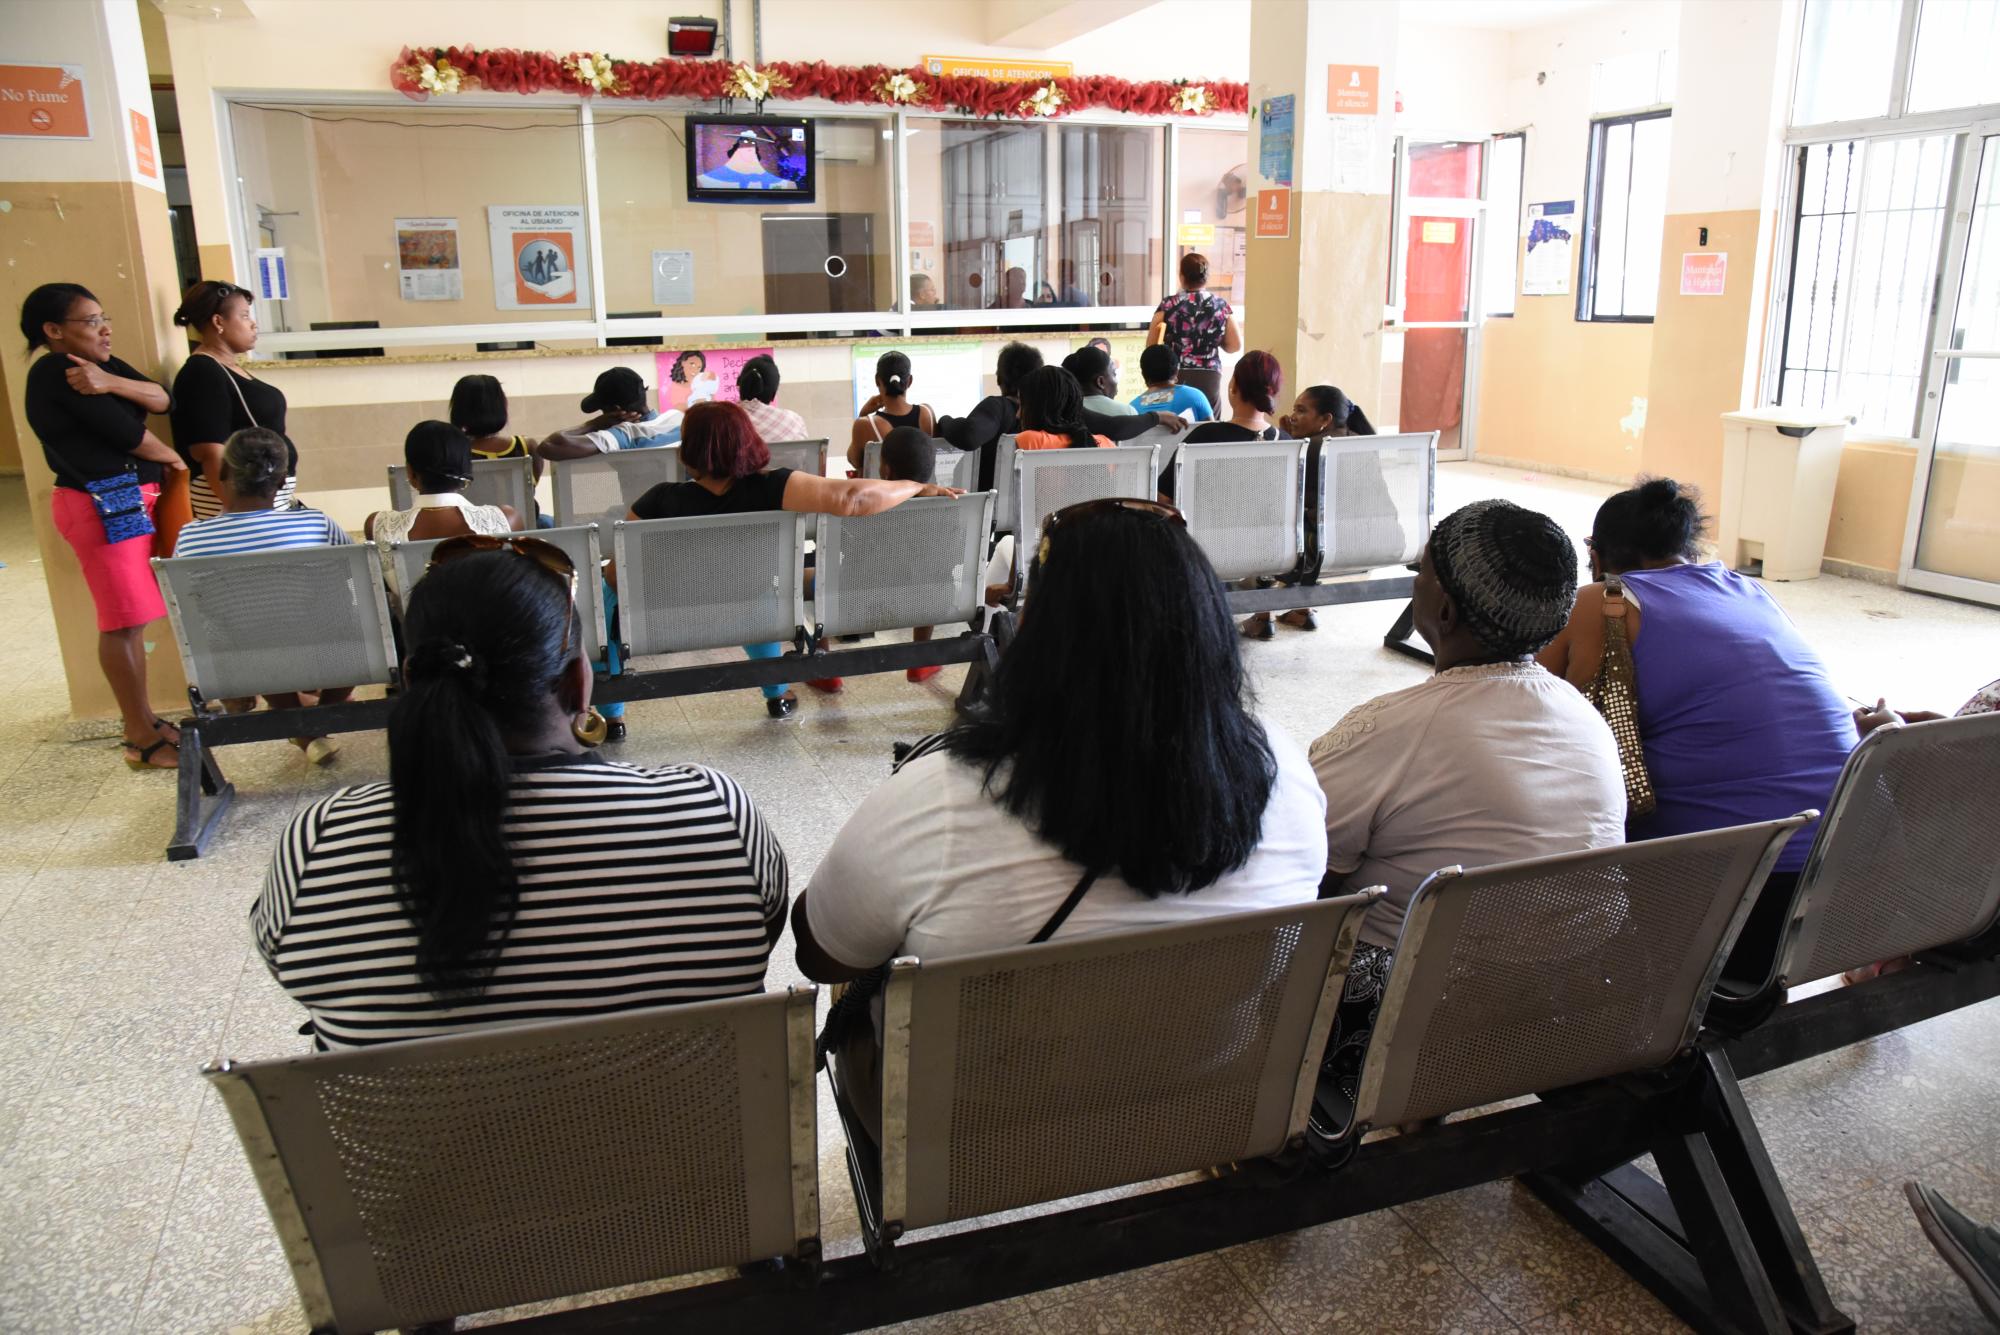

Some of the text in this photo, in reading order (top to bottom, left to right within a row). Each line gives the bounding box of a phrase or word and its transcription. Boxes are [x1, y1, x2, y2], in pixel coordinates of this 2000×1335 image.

[953, 67, 989, 78] OFICINA
[992, 68, 1004, 78] DE
[1, 88, 69, 104] No Fume
[722, 356, 748, 368] Decl
